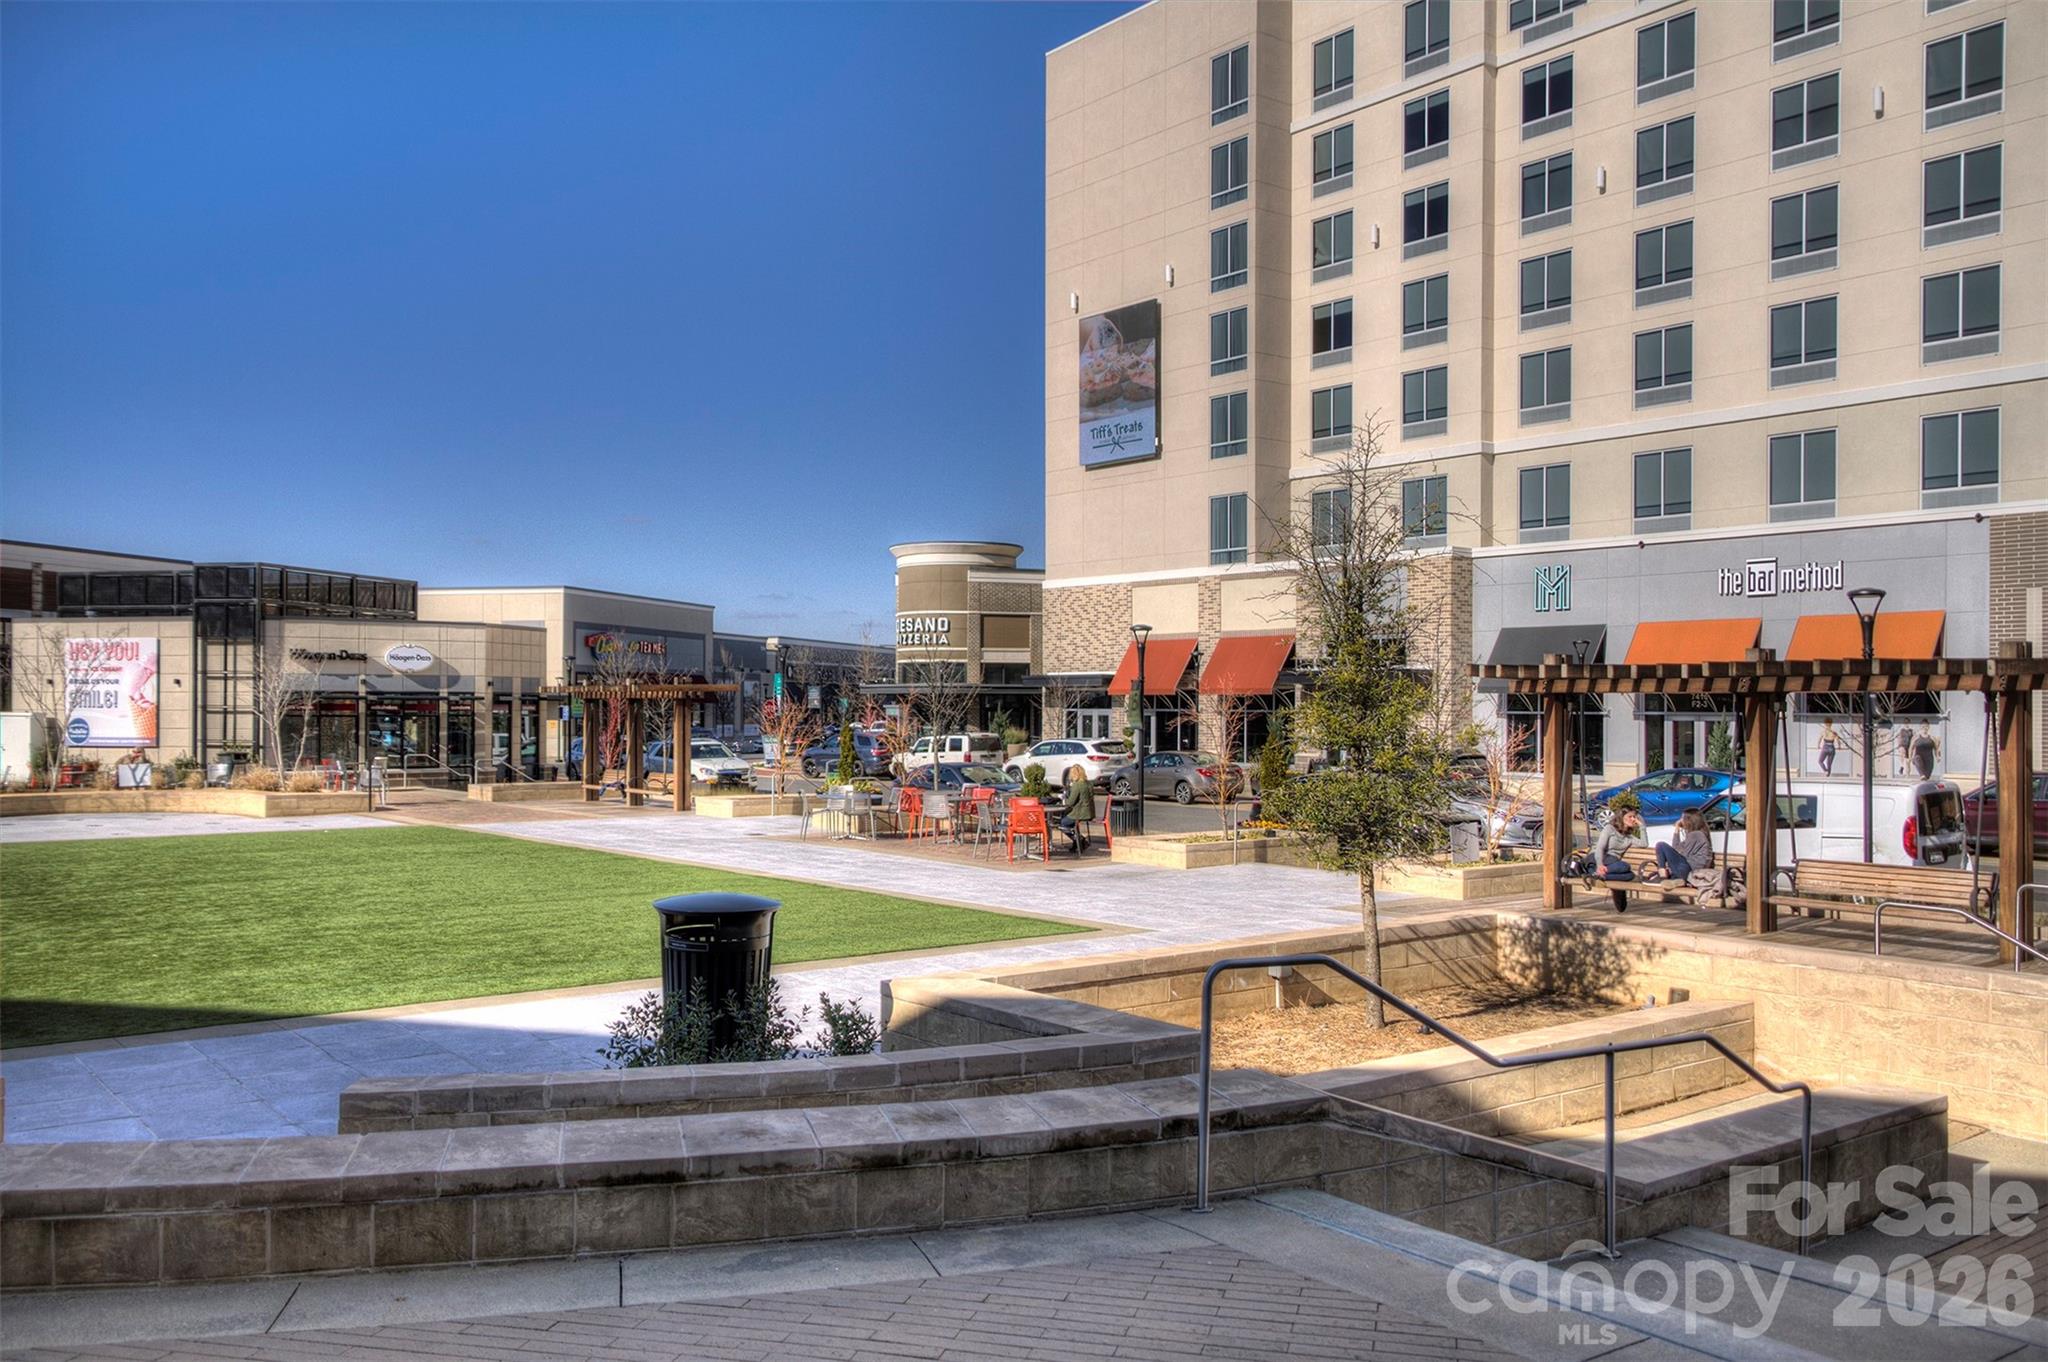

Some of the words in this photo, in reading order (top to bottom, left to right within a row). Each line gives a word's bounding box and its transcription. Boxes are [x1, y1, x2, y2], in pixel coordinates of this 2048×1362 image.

[1091, 424, 1112, 440] Tiff's
[1114, 421, 1143, 435] Treats
[1718, 568, 1743, 596] the
[1746, 562, 1776, 596] bar
[1780, 560, 1844, 593] method
[70, 642, 100, 661] HEY
[104, 642, 139, 661] YOU!
